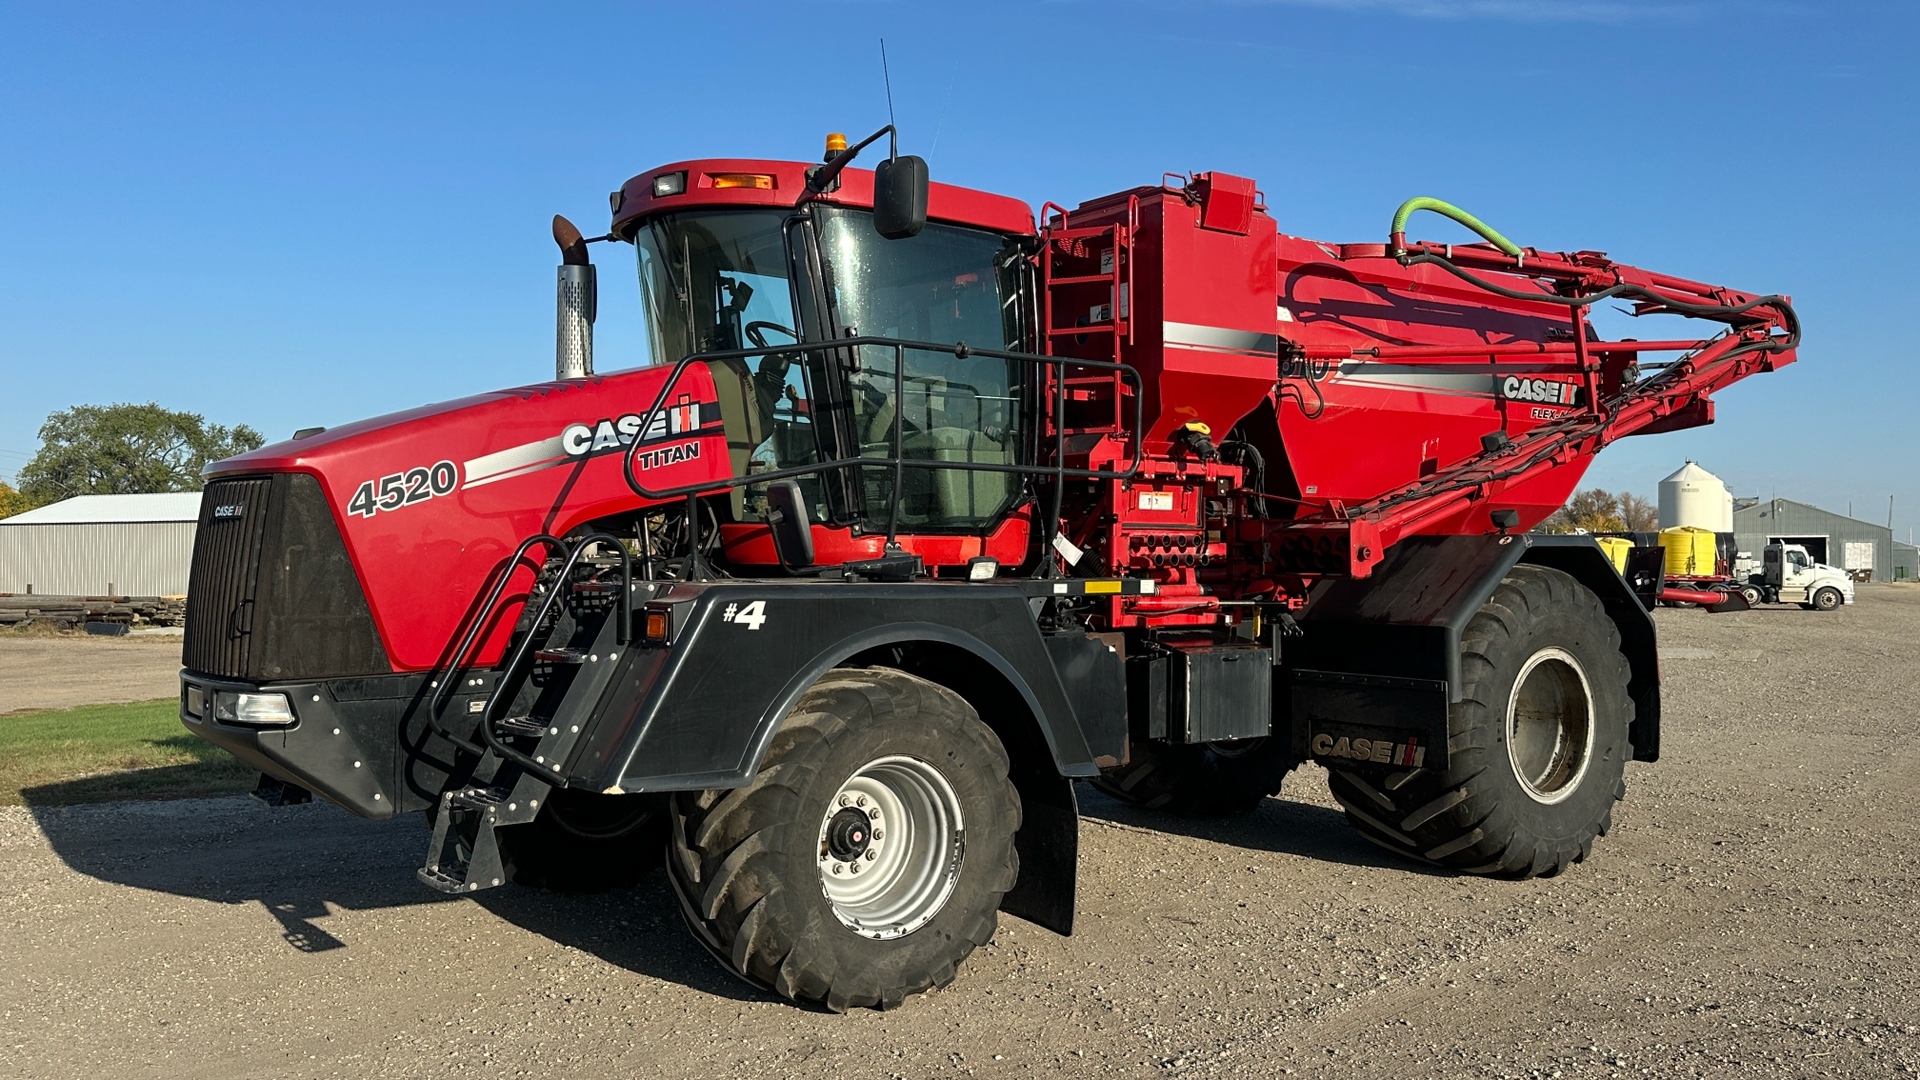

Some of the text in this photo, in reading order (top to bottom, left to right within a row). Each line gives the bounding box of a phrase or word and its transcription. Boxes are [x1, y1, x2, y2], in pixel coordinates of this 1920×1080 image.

[1503, 375, 1560, 403] CASE
[562, 409, 667, 456] CASE
[637, 440, 700, 471] TITAN
[347, 459, 458, 518] 4520
[214, 505, 235, 517] CASE
[723, 600, 767, 631] #4
[1311, 733, 1394, 764] CASE
